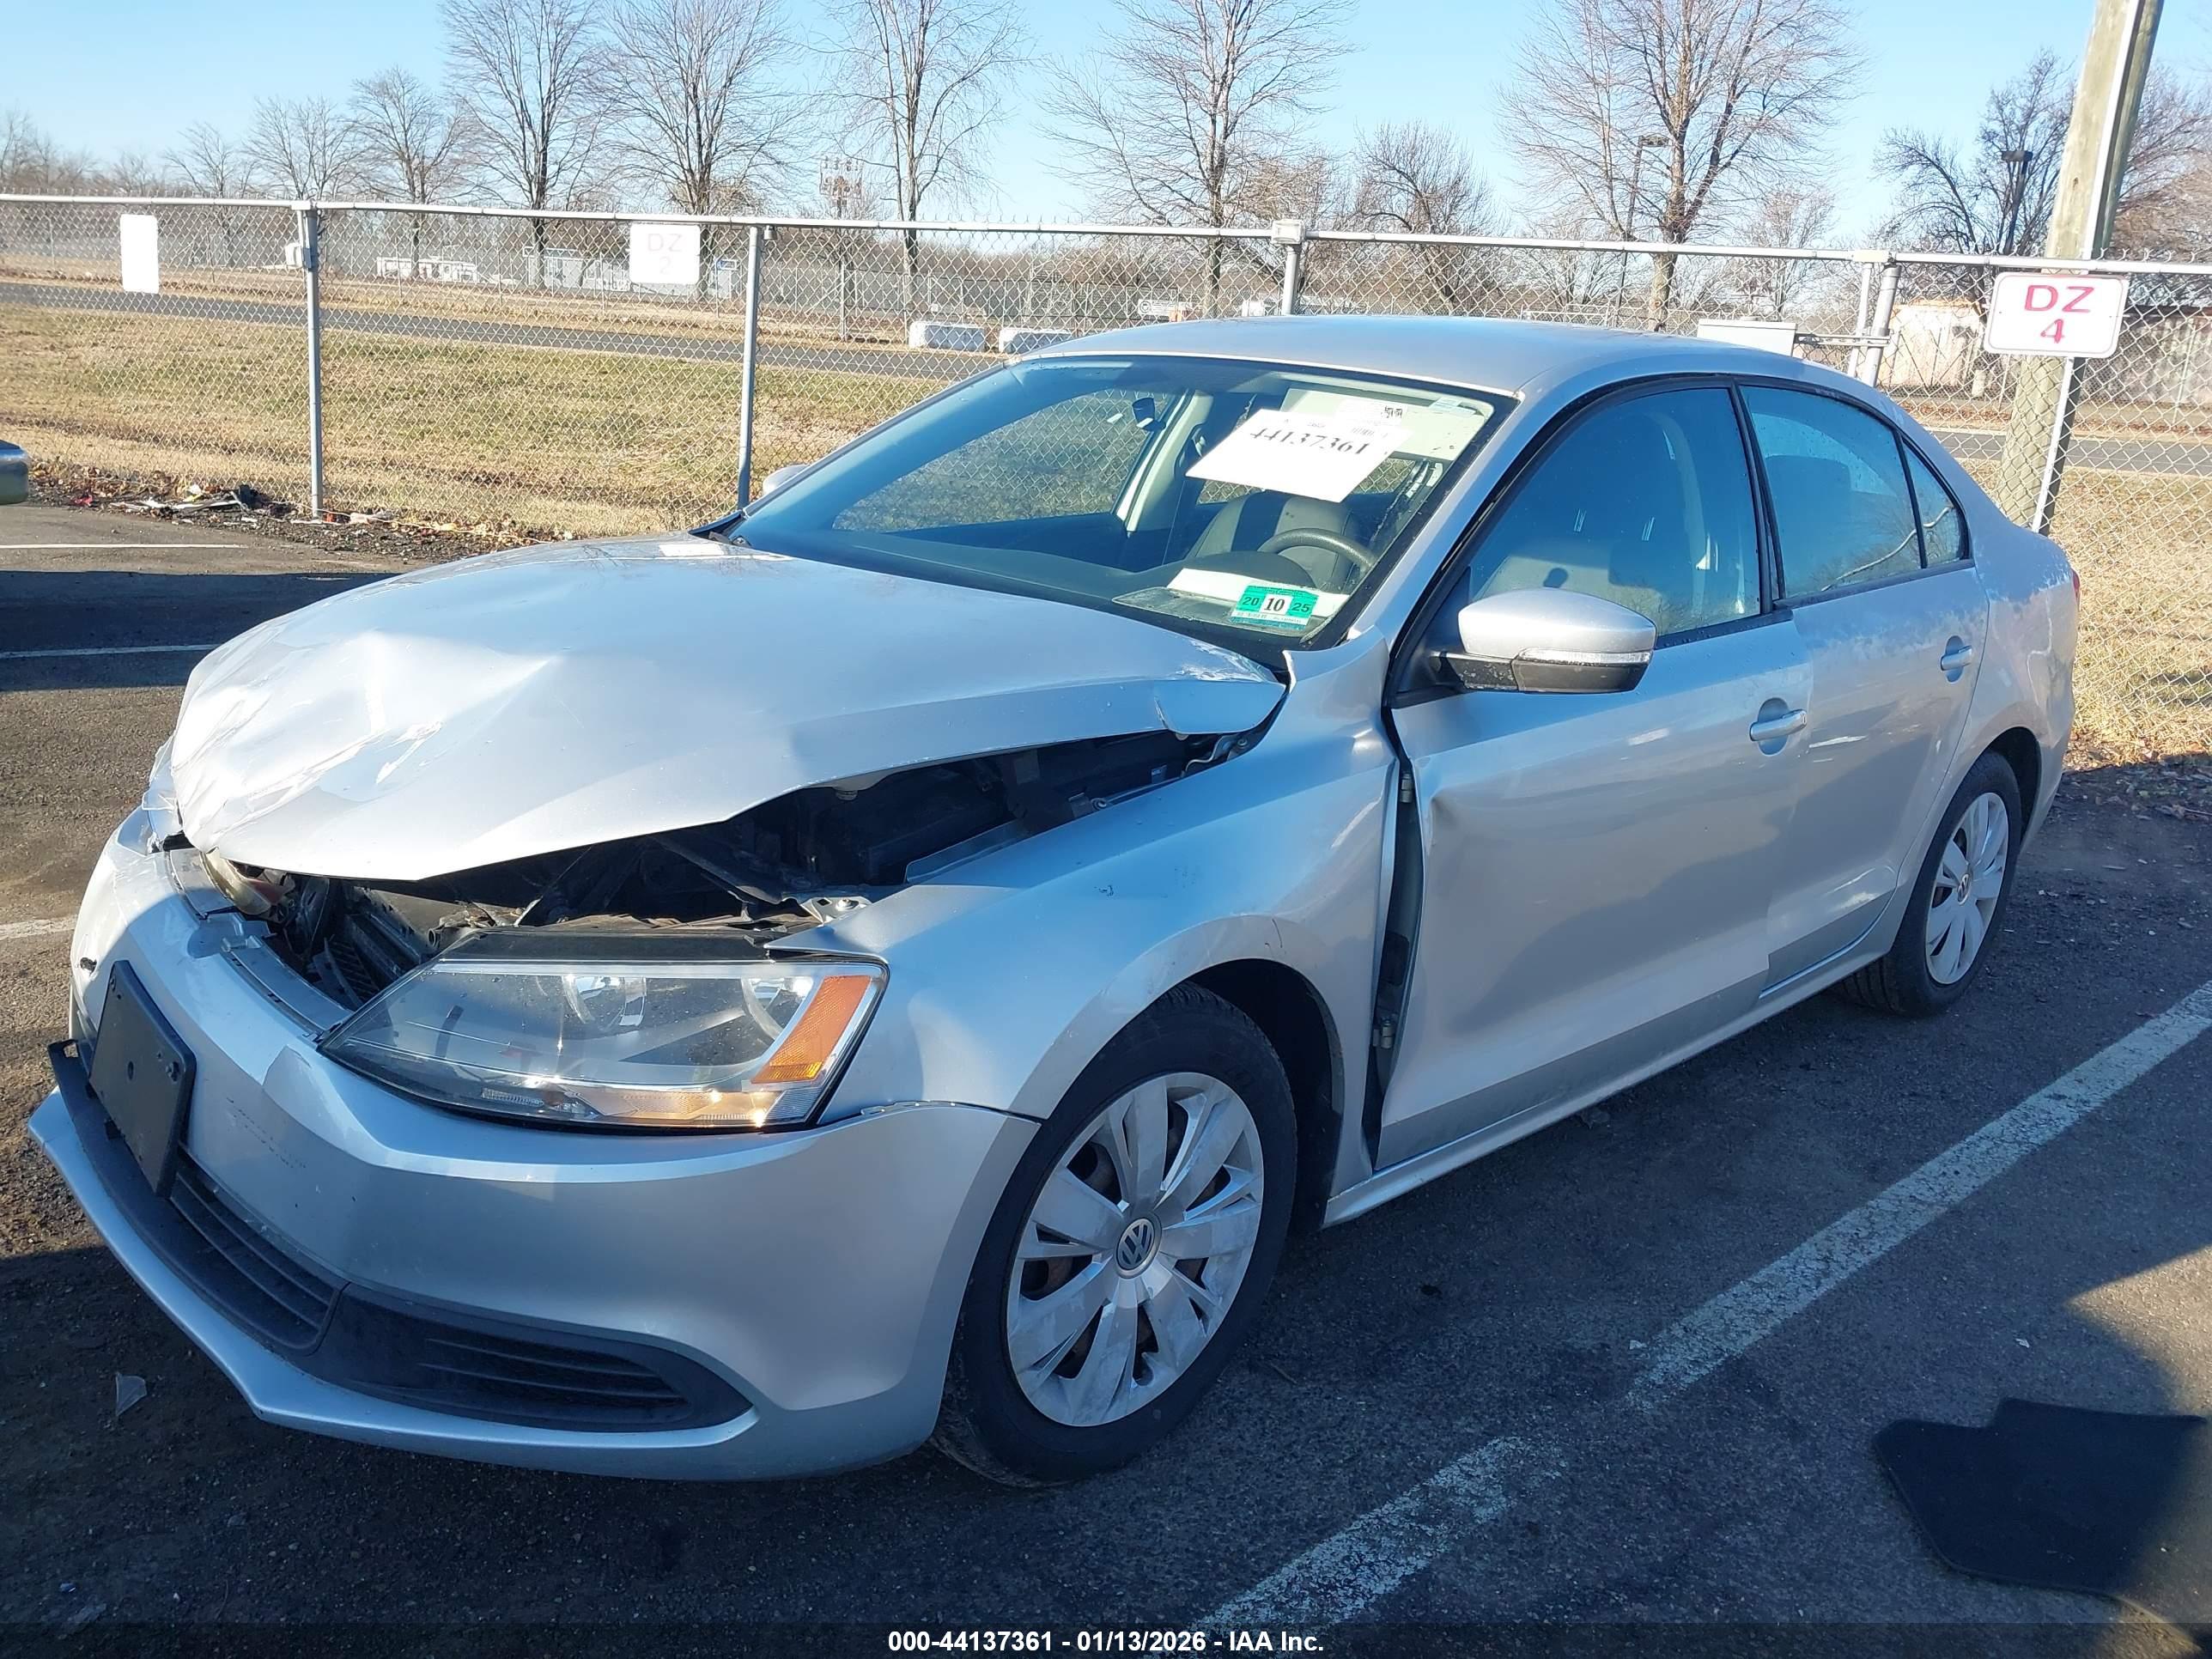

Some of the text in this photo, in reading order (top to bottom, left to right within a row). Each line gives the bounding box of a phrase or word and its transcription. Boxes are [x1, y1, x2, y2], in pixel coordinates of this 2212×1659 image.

[647, 233, 684, 252] DZ
[2024, 284, 2095, 313] DZ
[2040, 319, 2065, 343] 4
[1250, 428, 1370, 455] 44137361
[1243, 597, 1312, 612] 20 10 25
